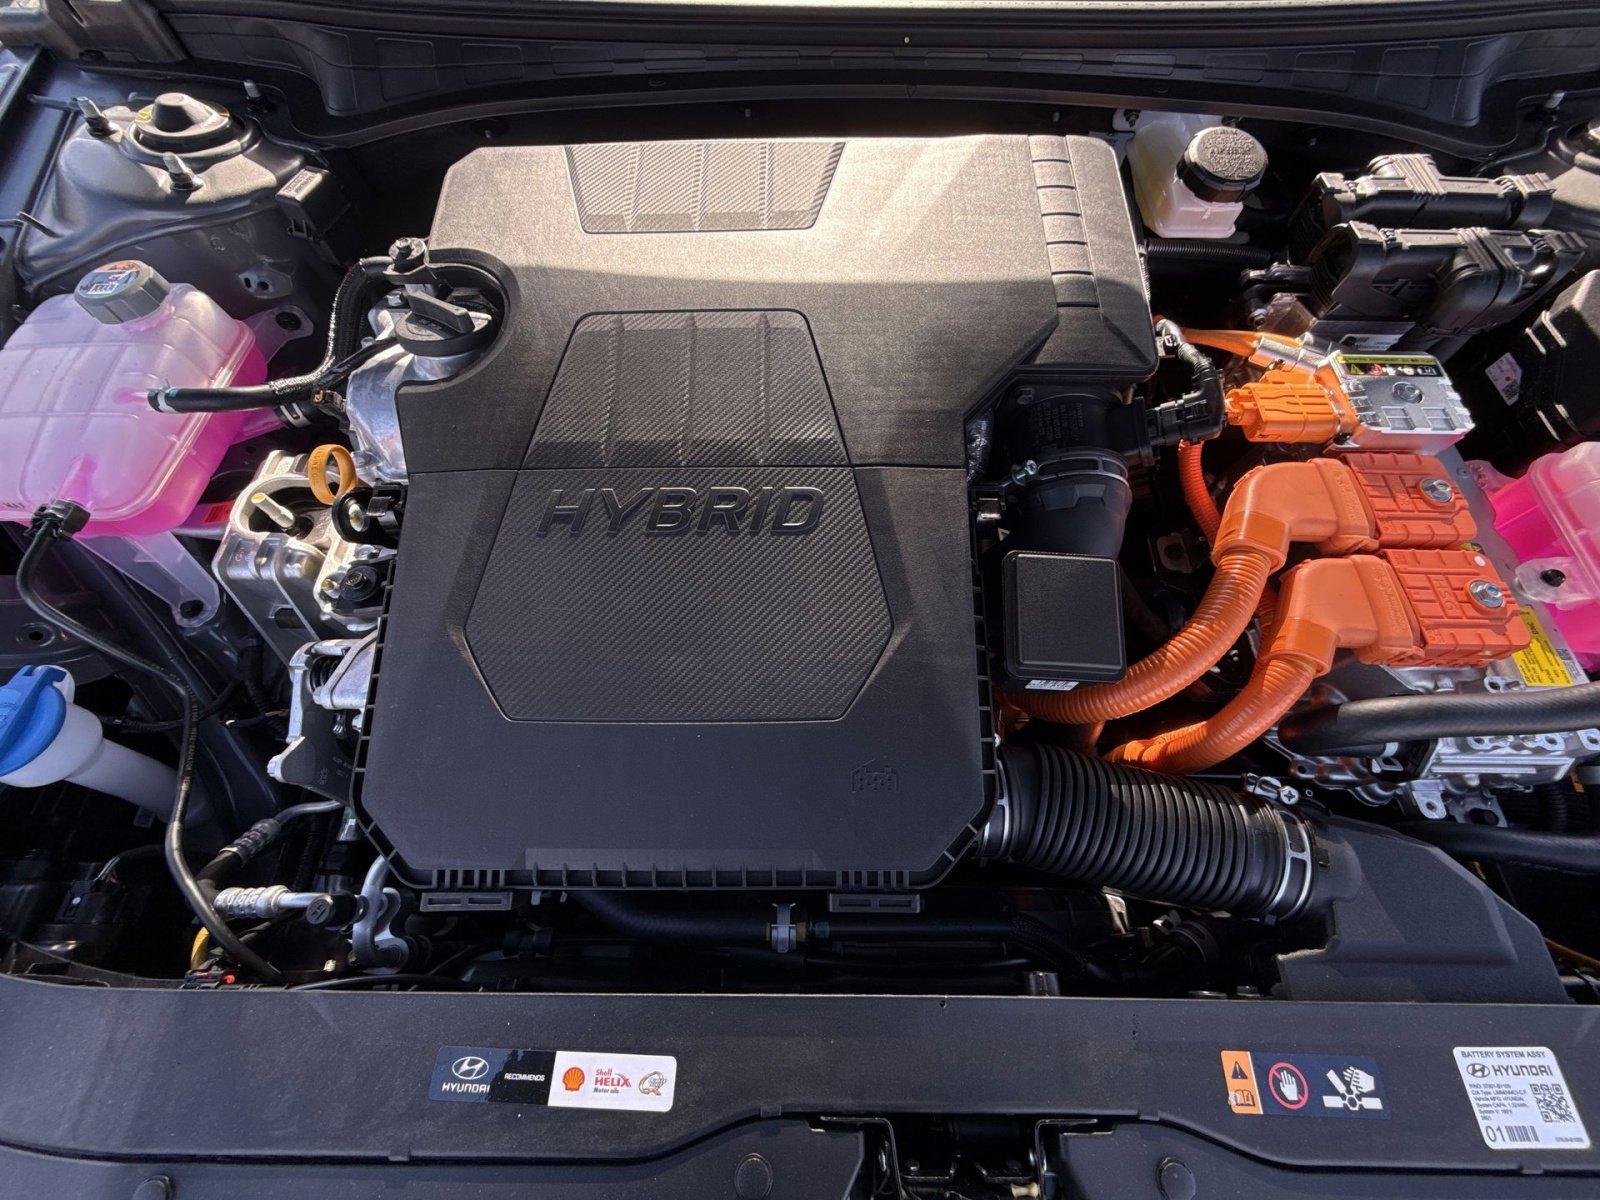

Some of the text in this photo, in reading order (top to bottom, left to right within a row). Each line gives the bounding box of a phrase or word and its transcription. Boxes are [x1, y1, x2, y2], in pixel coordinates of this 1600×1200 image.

[537, 487, 825, 535] HYBRID
[1431, 577, 1458, 611] HSG
[1461, 1051, 1546, 1059] BATTERY SYSTEM ASSY
[1491, 1064, 1554, 1076] HYUNDAI
[504, 1072, 545, 1081] RECOMMENDS
[594, 1077, 631, 1087] HELIX
[442, 1082, 490, 1093] HYUNDAI
[1485, 1125, 1506, 1142] 01
